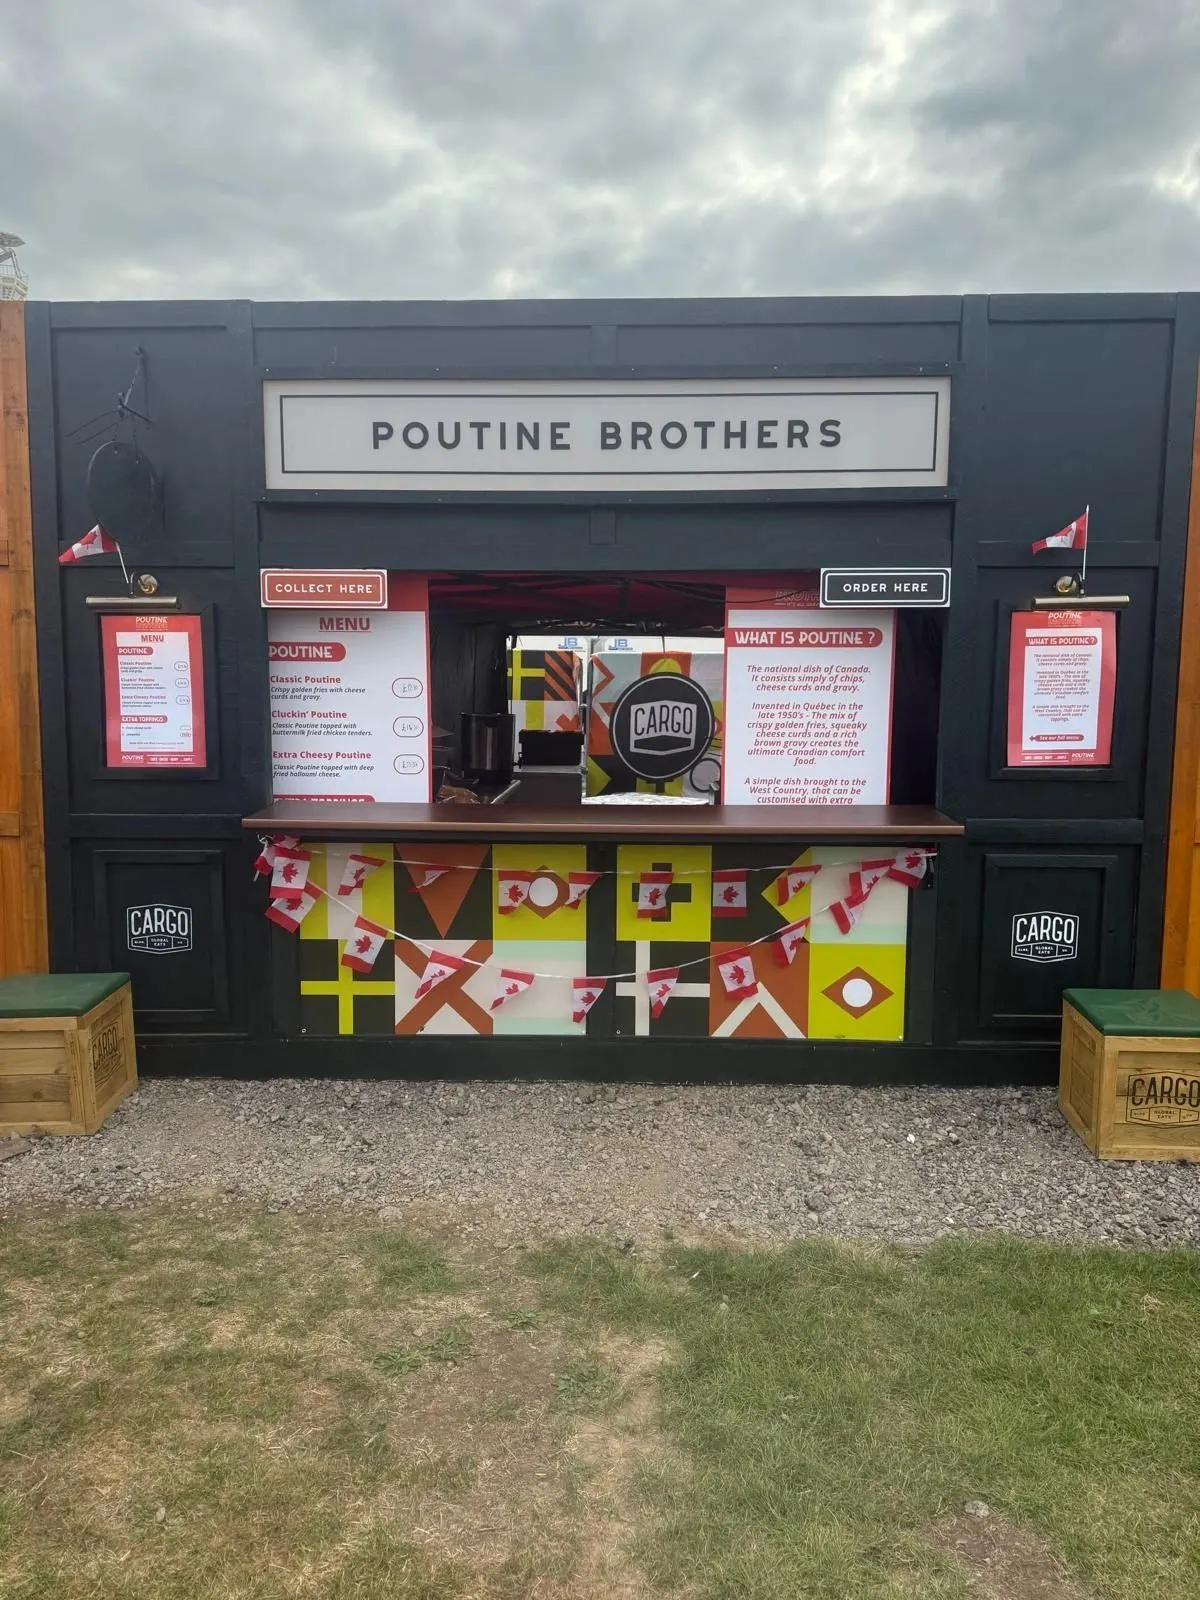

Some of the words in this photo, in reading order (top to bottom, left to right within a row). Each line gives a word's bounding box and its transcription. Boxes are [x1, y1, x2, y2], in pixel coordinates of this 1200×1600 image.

[372, 421, 570, 450] POUTINE
[600, 419, 841, 449] BROTHERS
[275, 584, 333, 593] COLLECT
[339, 585, 373, 593] HERE
[843, 583, 887, 592] ORDER
[894, 583, 928, 592] HERE
[135, 616, 168, 624] POUTINE
[1047, 612, 1081, 620] POUTINE
[319, 617, 371, 631] MENU
[141, 634, 165, 643] MENU
[734, 631, 777, 645] WHAT
[781, 631, 794, 645] IS
[798, 631, 863, 645] POUTINE
[868, 632, 876, 645] ?
[1028, 637, 1049, 645] WHAT
[1050, 637, 1057, 645] IS
[1058, 637, 1089, 645] POUTINE
[269, 645, 333, 658] POUTINE
[747, 665, 761, 673] The
[764, 665, 801, 673] national
[803, 665, 821, 673] dish
[823, 665, 834, 675] of
[835, 665, 871, 673] Canada.
[270, 675, 302, 684] Classic
[304, 675, 342, 684] Poutine
[751, 674, 759, 682] It
[760, 674, 796, 682] consists
[798, 674, 827, 684] simply
[829, 674, 838, 684] of
[840, 674, 865, 684] chips,
[270, 686, 291, 694] Crispy
[291, 686, 313, 695] golden
[313, 686, 328, 695] fries
[756, 683, 786, 692] cheese
[788, 683, 812, 692] curds
[814, 683, 831, 692] and
[832, 685, 860, 694] gravy.
[752, 702, 790, 710] Invented
[792, 702, 801, 710] in
[803, 702, 835, 712] Québec
[837, 702, 847, 710] in
[848, 702, 864, 710] the
[271, 711, 309, 719] Cluckin'
[311, 711, 348, 719] Poutine
[634, 704, 693, 736] CARGO
[757, 711, 775, 719] late
[777, 711, 804, 719] 1950's
[811, 711, 827, 719] The
[829, 711, 845, 719] mix
[847, 711, 858, 721] of
[319, 722, 342, 730] topped
[747, 721, 772, 731] crispy
[774, 721, 804, 731] golden
[805, 721, 828, 732] fries,
[830, 721, 868, 731] squeaky
[306, 729, 322, 737] fried
[756, 730, 786, 738] cheese
[788, 730, 811, 738] curds
[813, 730, 831, 738] and
[840, 730, 857, 738] rich
[754, 739, 782, 747] brown
[783, 740, 808, 749] gravy
[809, 739, 841, 747] creates
[844, 739, 859, 747] the
[272, 751, 298, 759] Extra
[299, 751, 333, 760] Cheesy
[335, 751, 372, 759] Poutine
[747, 748, 785, 756] ultimate
[786, 748, 828, 756] Canadian
[830, 748, 866, 758] comfort
[794, 757, 817, 767] food.
[744, 777, 751, 785] A
[752, 777, 781, 786] simple
[783, 777, 802, 785] dish
[803, 777, 838, 787] brought
[852, 778, 867, 786] the
[749, 786, 771, 794] West
[772, 786, 809, 796] Country,
[811, 786, 831, 795] that
[850, 787, 862, 795] be
[757, 796, 807, 804] customised
[808, 796, 827, 804] with
[829, 797, 853, 805] extra
[130, 907, 189, 936] CARGO
[1015, 915, 1075, 944] CARGO
[92, 1027, 118, 1071] CARGO
[1131, 1076, 1200, 1108] CARGO
